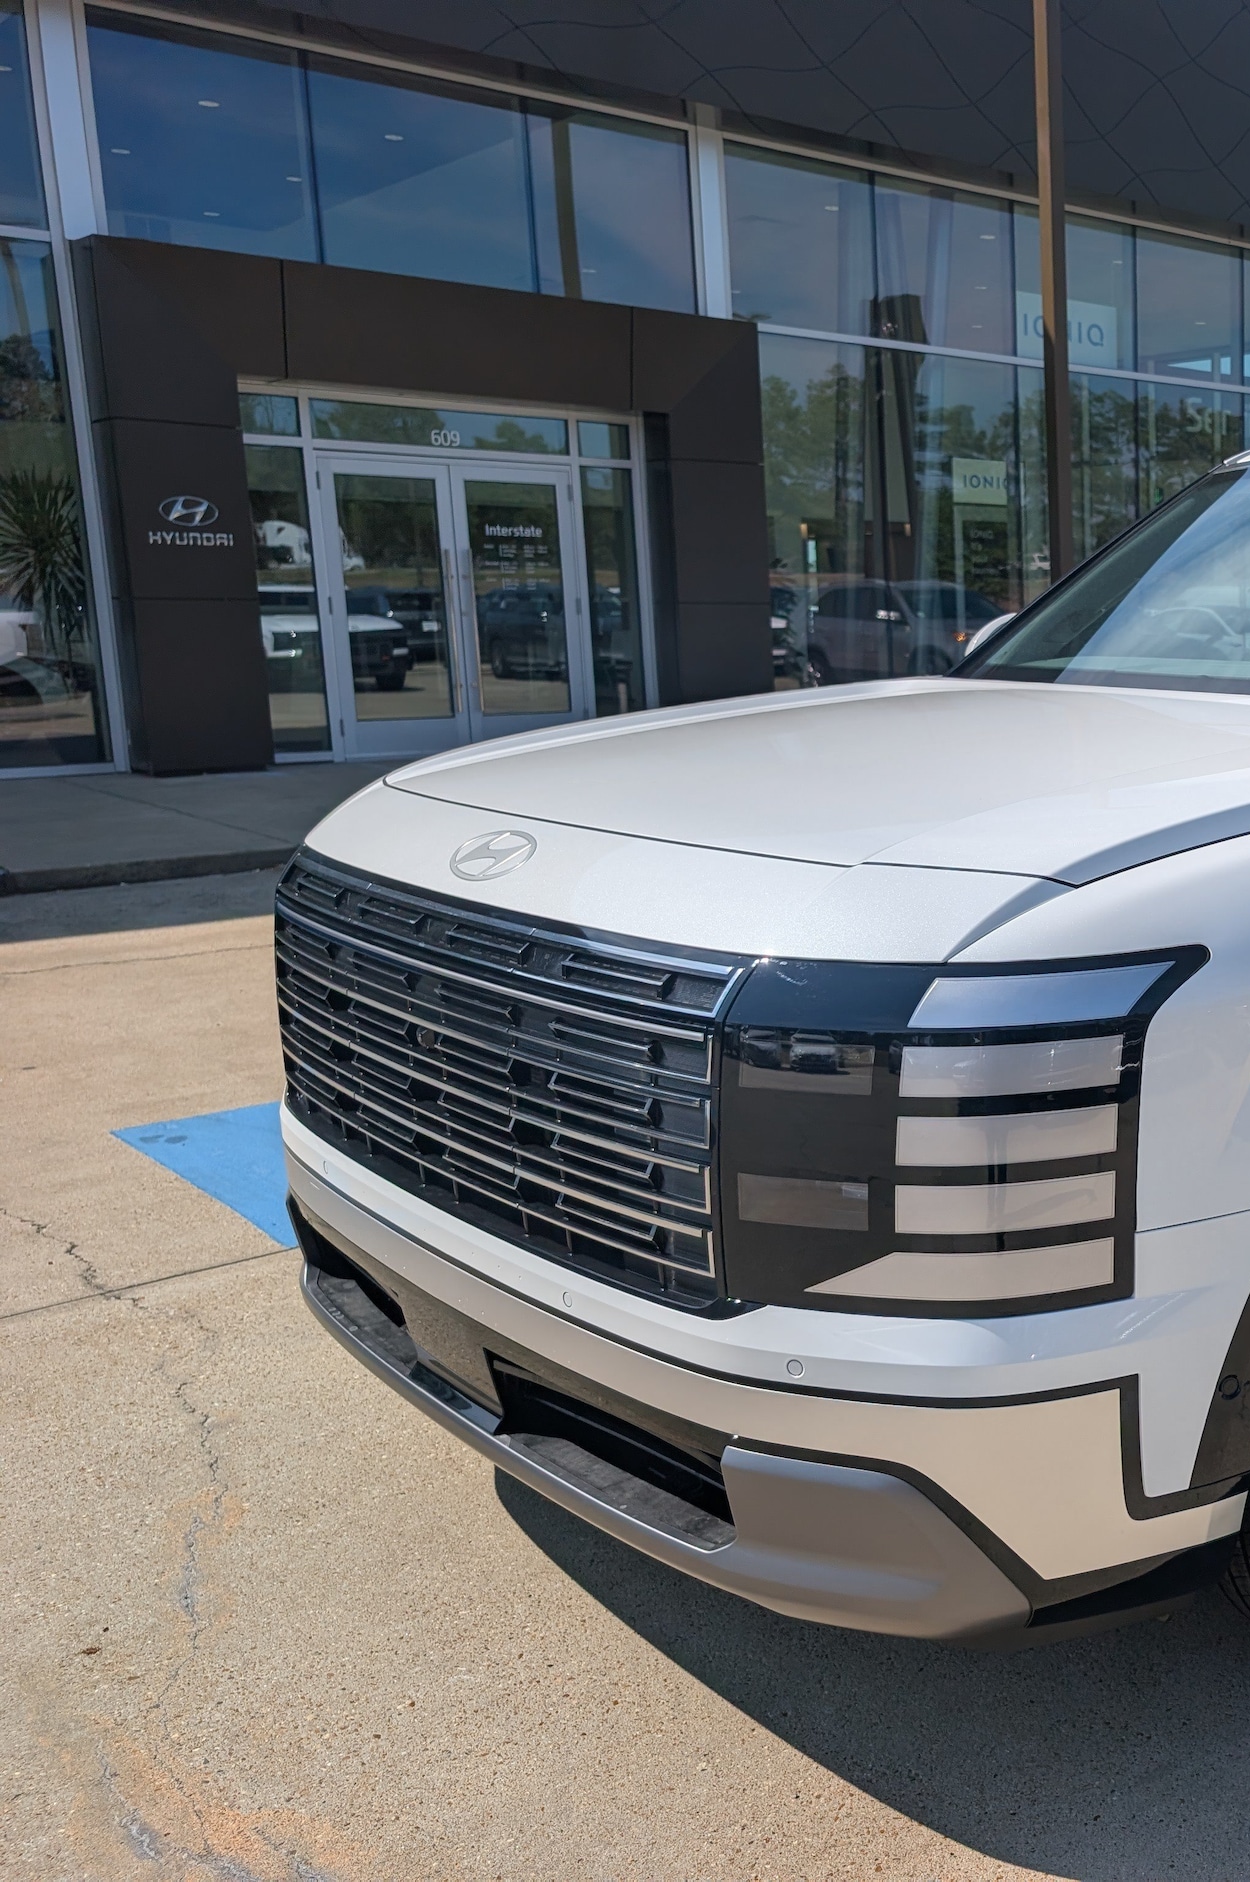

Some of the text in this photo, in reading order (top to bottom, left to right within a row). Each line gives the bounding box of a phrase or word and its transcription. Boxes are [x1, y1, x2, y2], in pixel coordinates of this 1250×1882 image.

[431, 429, 460, 447] 609
[485, 523, 542, 538] Interstate
[148, 531, 234, 547] HYUNDAI
